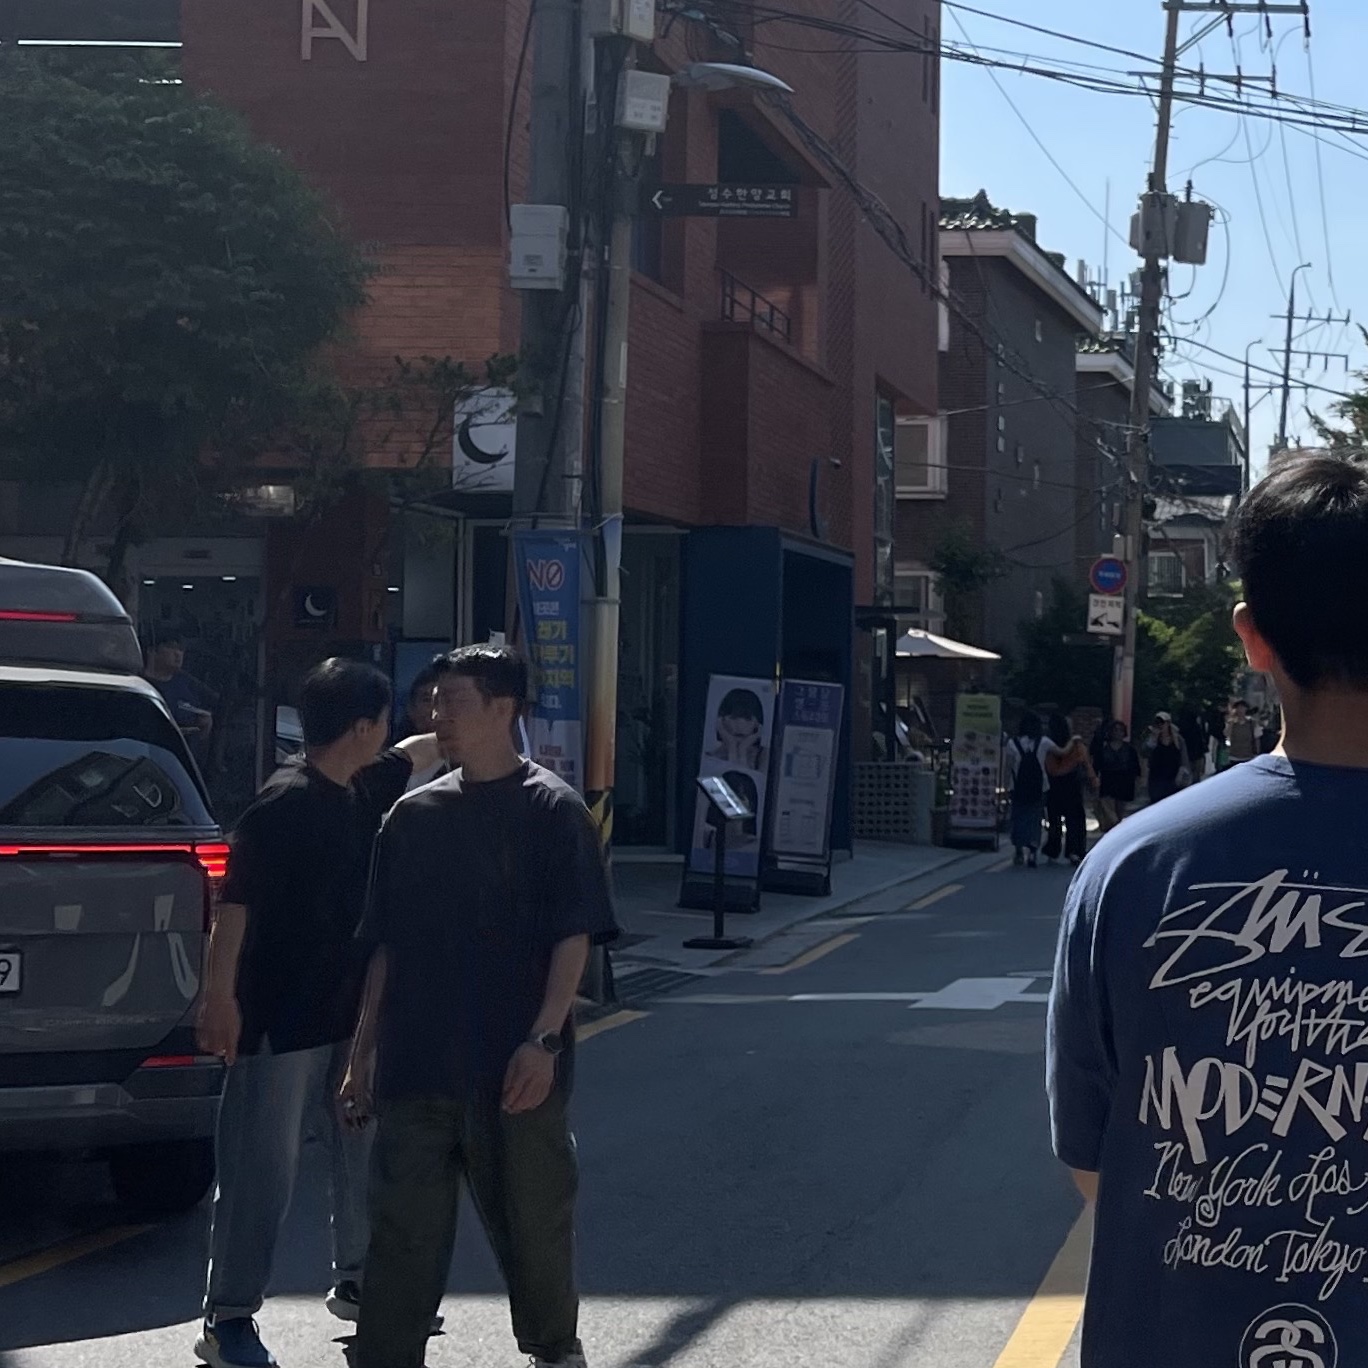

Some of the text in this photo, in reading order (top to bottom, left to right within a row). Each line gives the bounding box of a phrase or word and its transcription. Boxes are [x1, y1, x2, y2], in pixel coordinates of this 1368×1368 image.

[1233, 1000, 1299, 1068] for
[1143, 1141, 1199, 1203] New
[1195, 1142, 1284, 1227] York
[1289, 1146, 1366, 1226] Los
[1163, 1216, 1269, 1270] London
[1264, 1216, 1366, 1301] Tokyo
